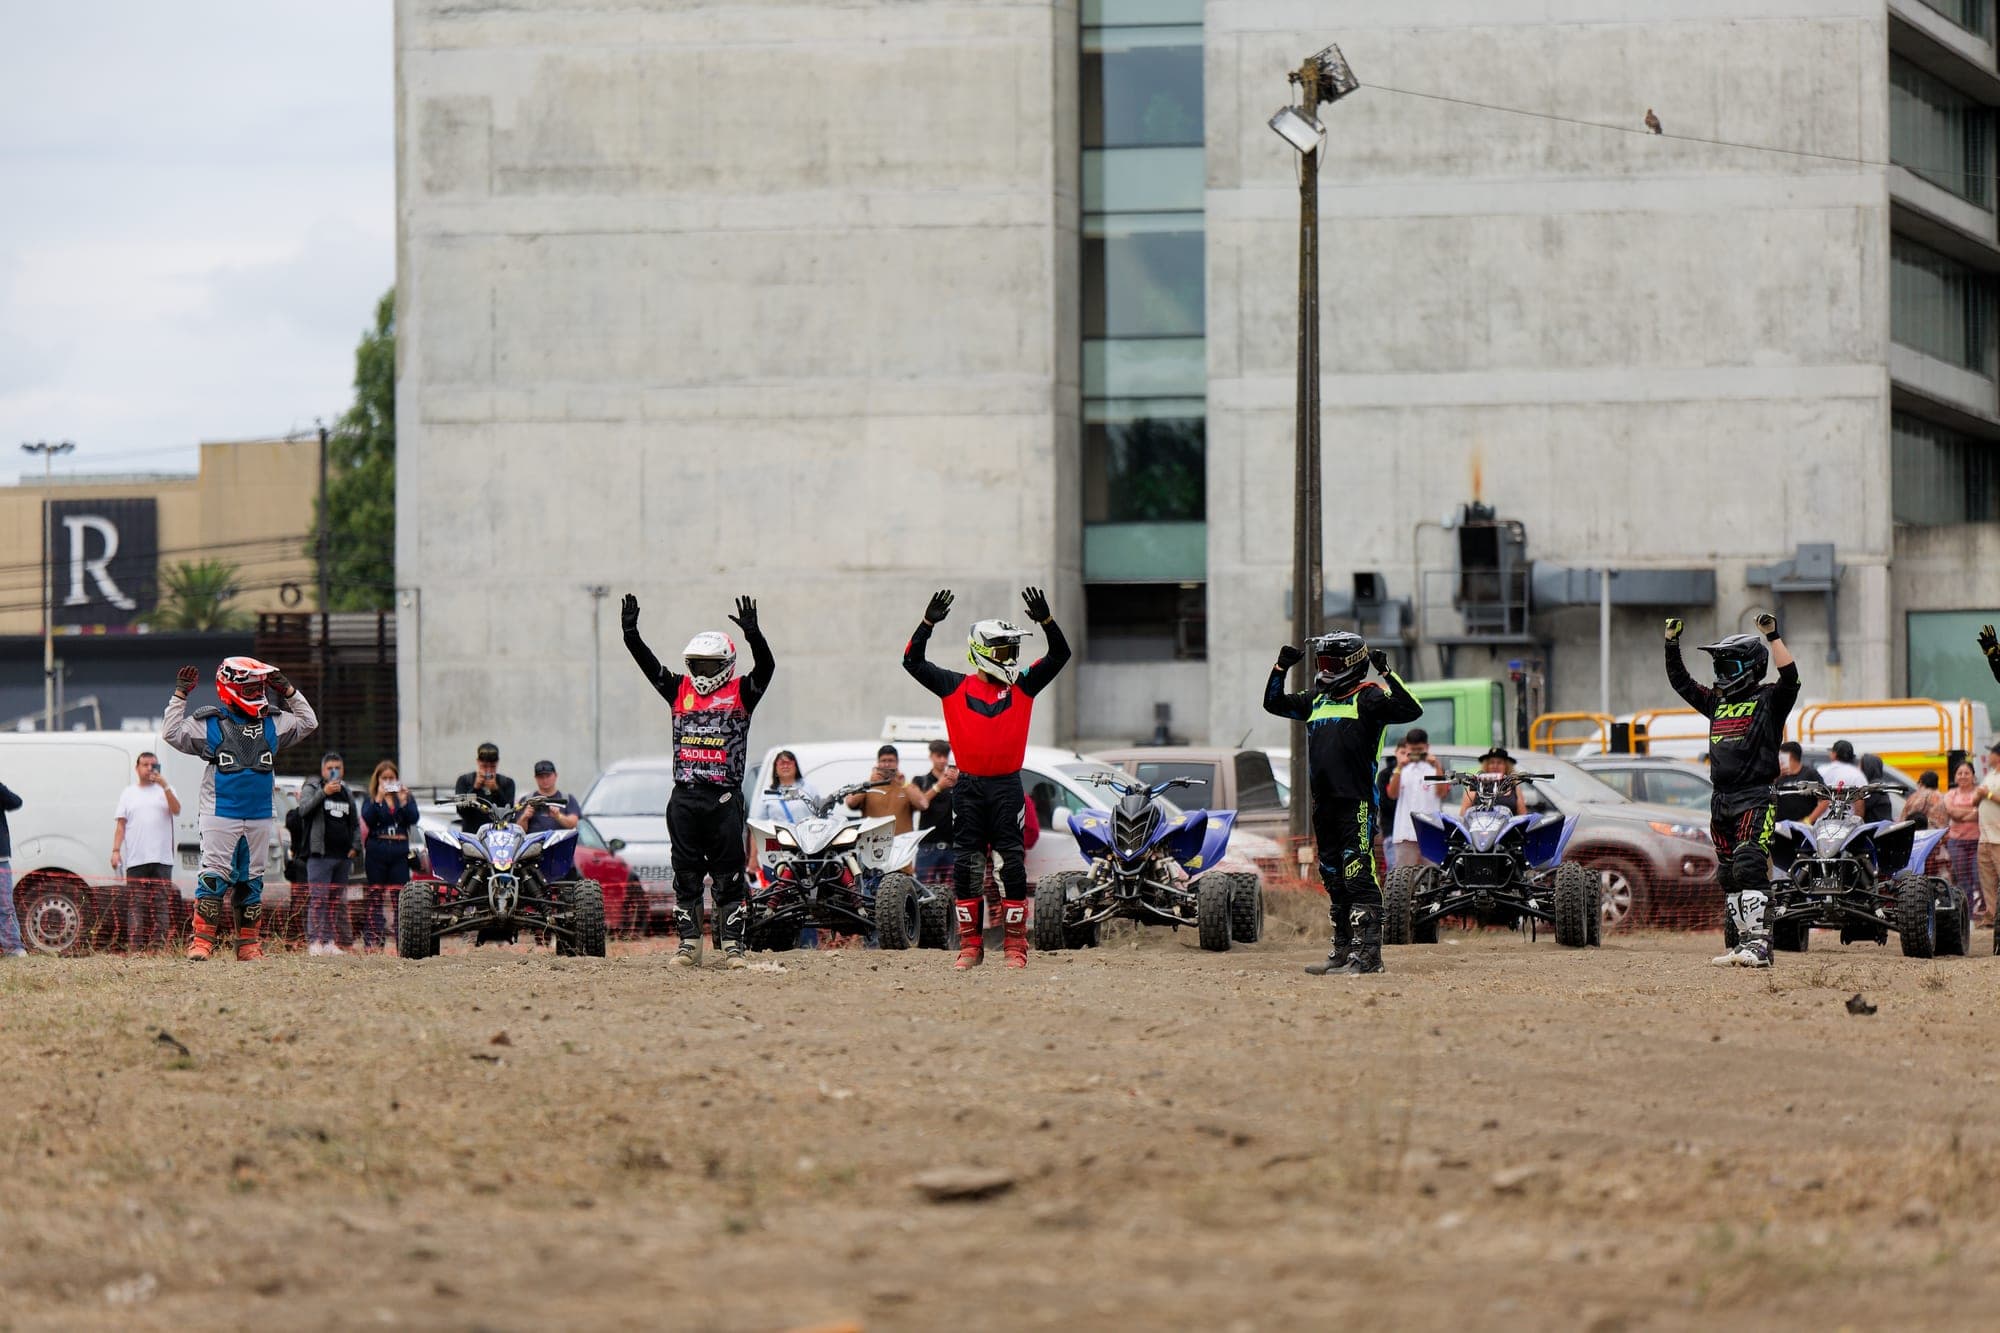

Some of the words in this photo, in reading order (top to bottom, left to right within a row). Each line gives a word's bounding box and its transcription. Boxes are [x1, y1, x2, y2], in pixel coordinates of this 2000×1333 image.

[62, 515, 136, 610] R
[681, 748, 722, 760] PADILLA
[1006, 907, 1025, 923] G
